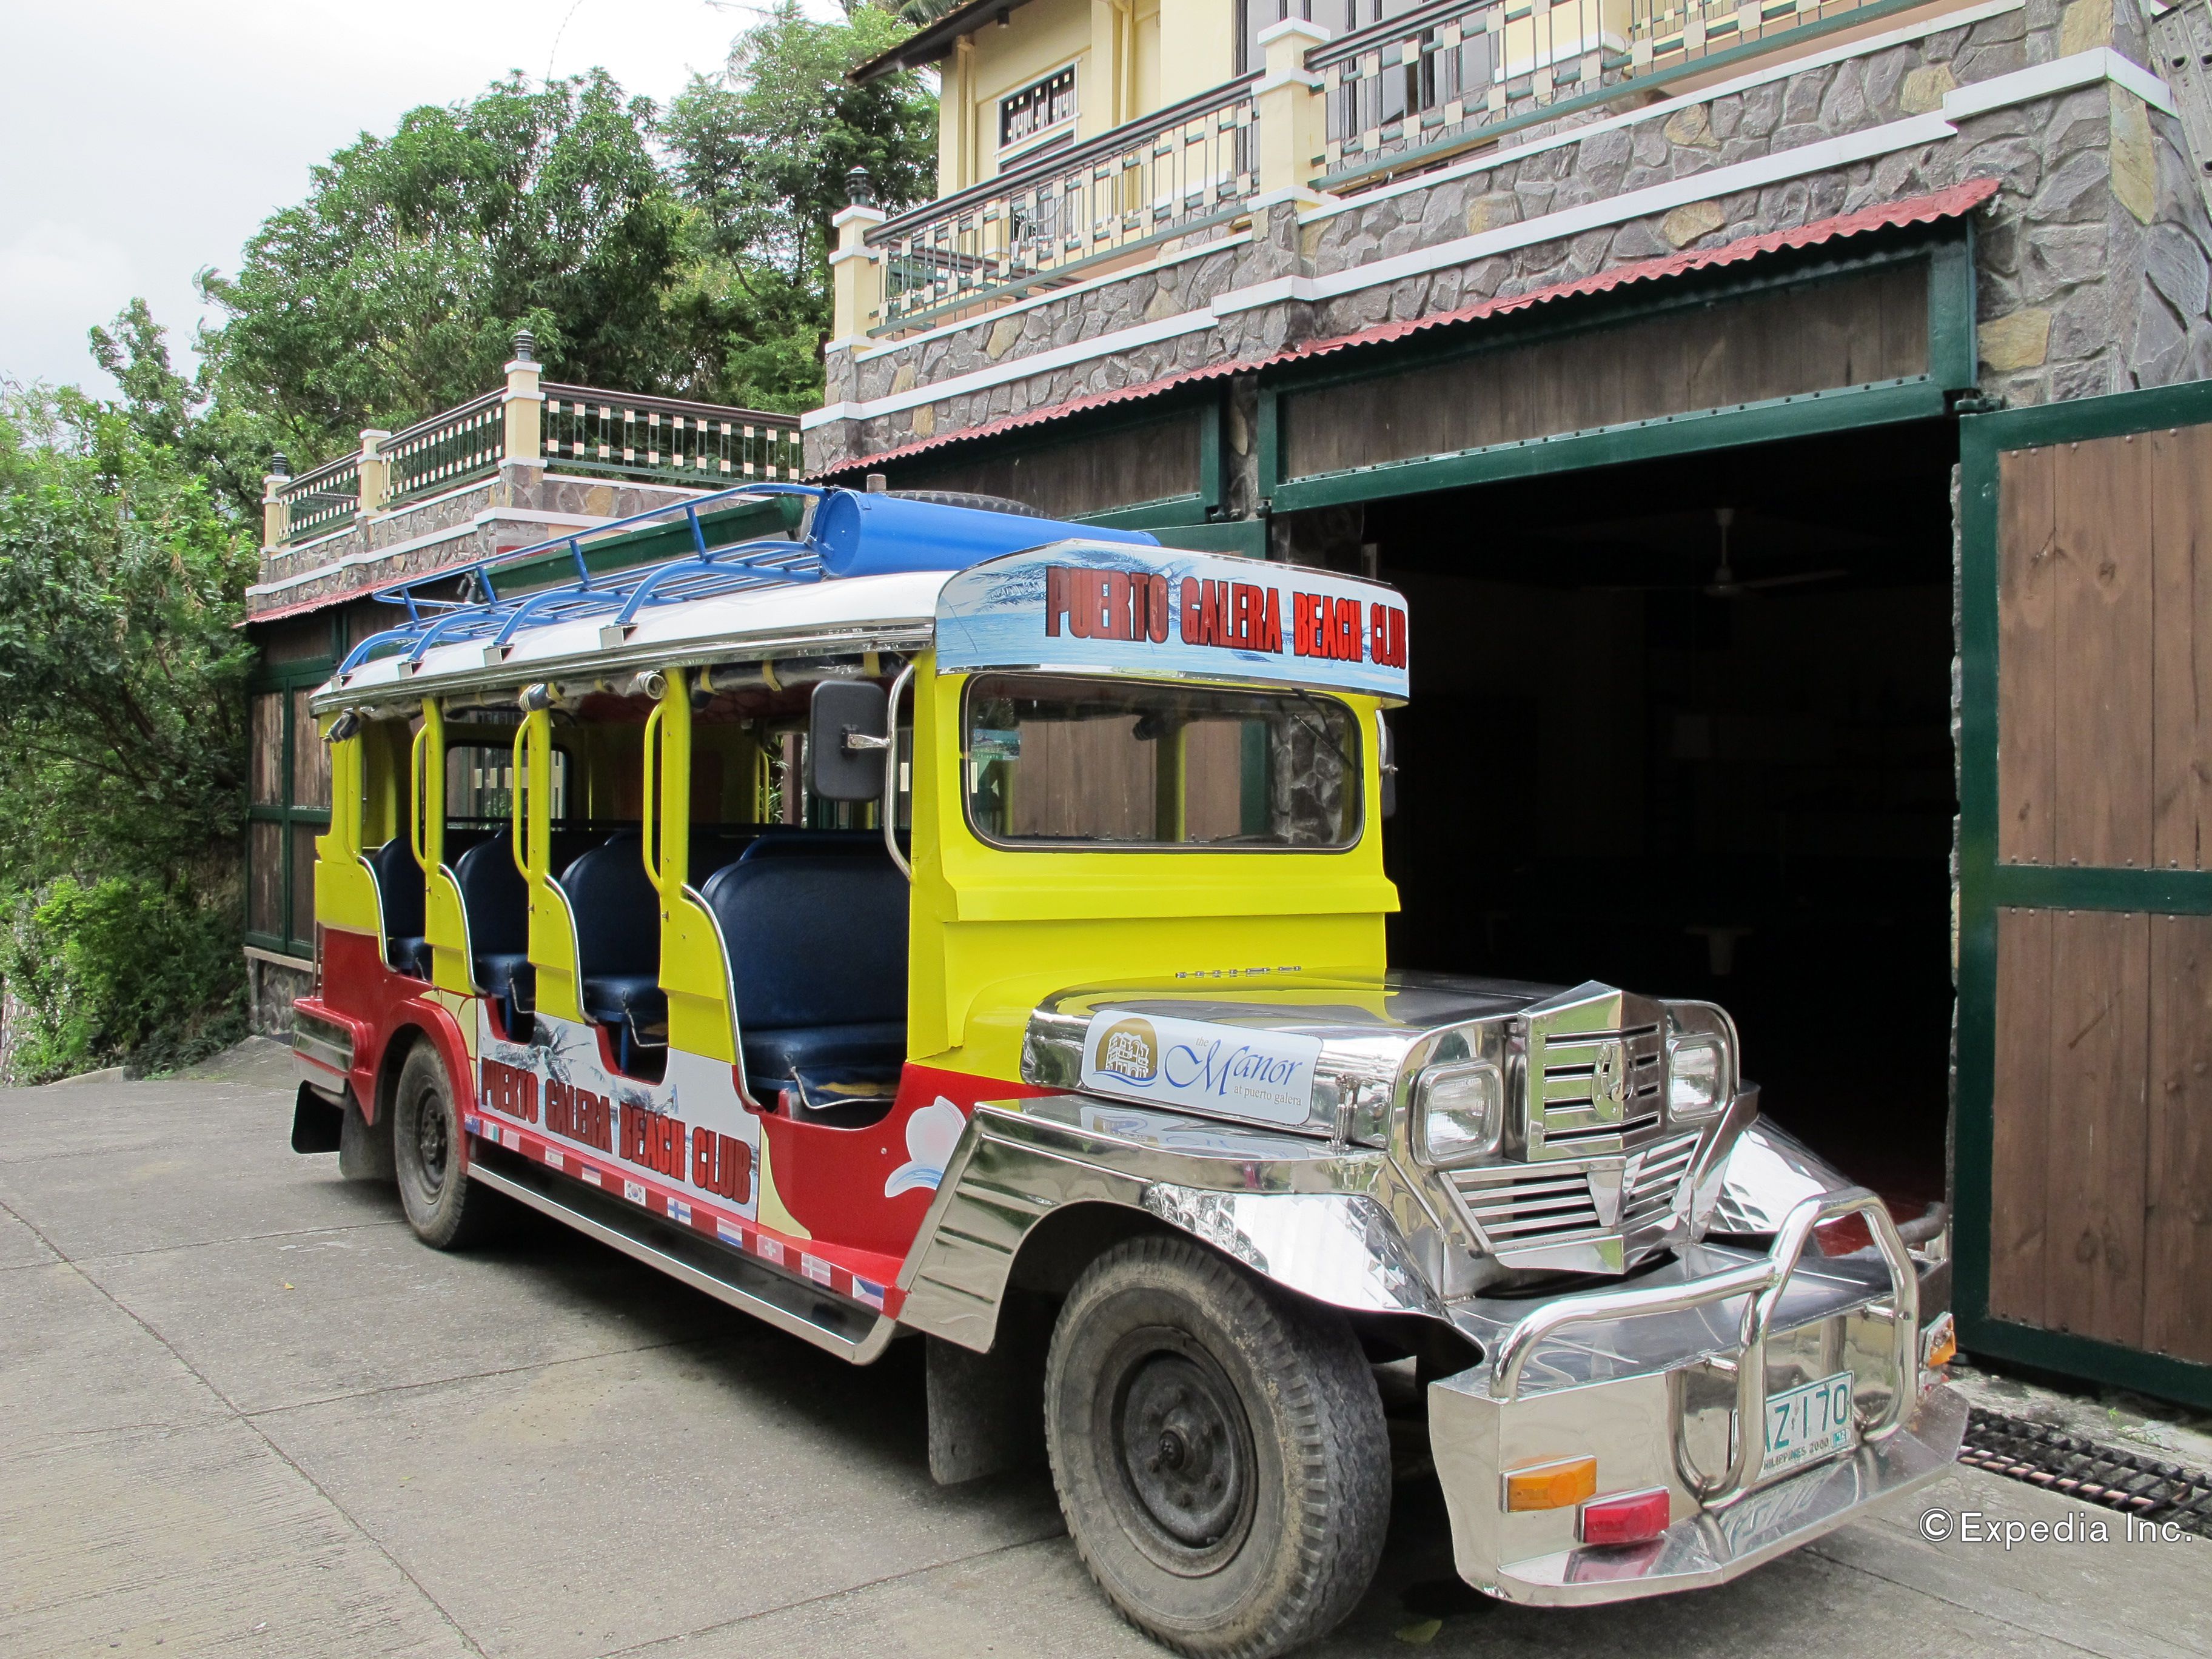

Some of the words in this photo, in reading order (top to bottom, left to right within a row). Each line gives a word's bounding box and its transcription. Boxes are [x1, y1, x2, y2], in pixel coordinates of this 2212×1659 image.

[1046, 565, 1169, 644] PUERTO
[1180, 576, 1284, 655] GALERA
[1293, 591, 1363, 663] BEACH
[1370, 602, 1407, 670] CLUB
[1195, 1036, 1209, 1047] the
[1164, 1039, 1303, 1096] Manor
[1234, 1085, 1242, 1094] at
[1244, 1087, 1272, 1101] puerto
[1274, 1092, 1301, 1105] galera
[481, 1057, 538, 1124] PUERTO
[545, 1078, 612, 1154] GALERA
[619, 1101, 686, 1182] BEACH
[692, 1126, 752, 1205] CLUB
[1763, 1446, 1807, 1470] HILIPPINES
